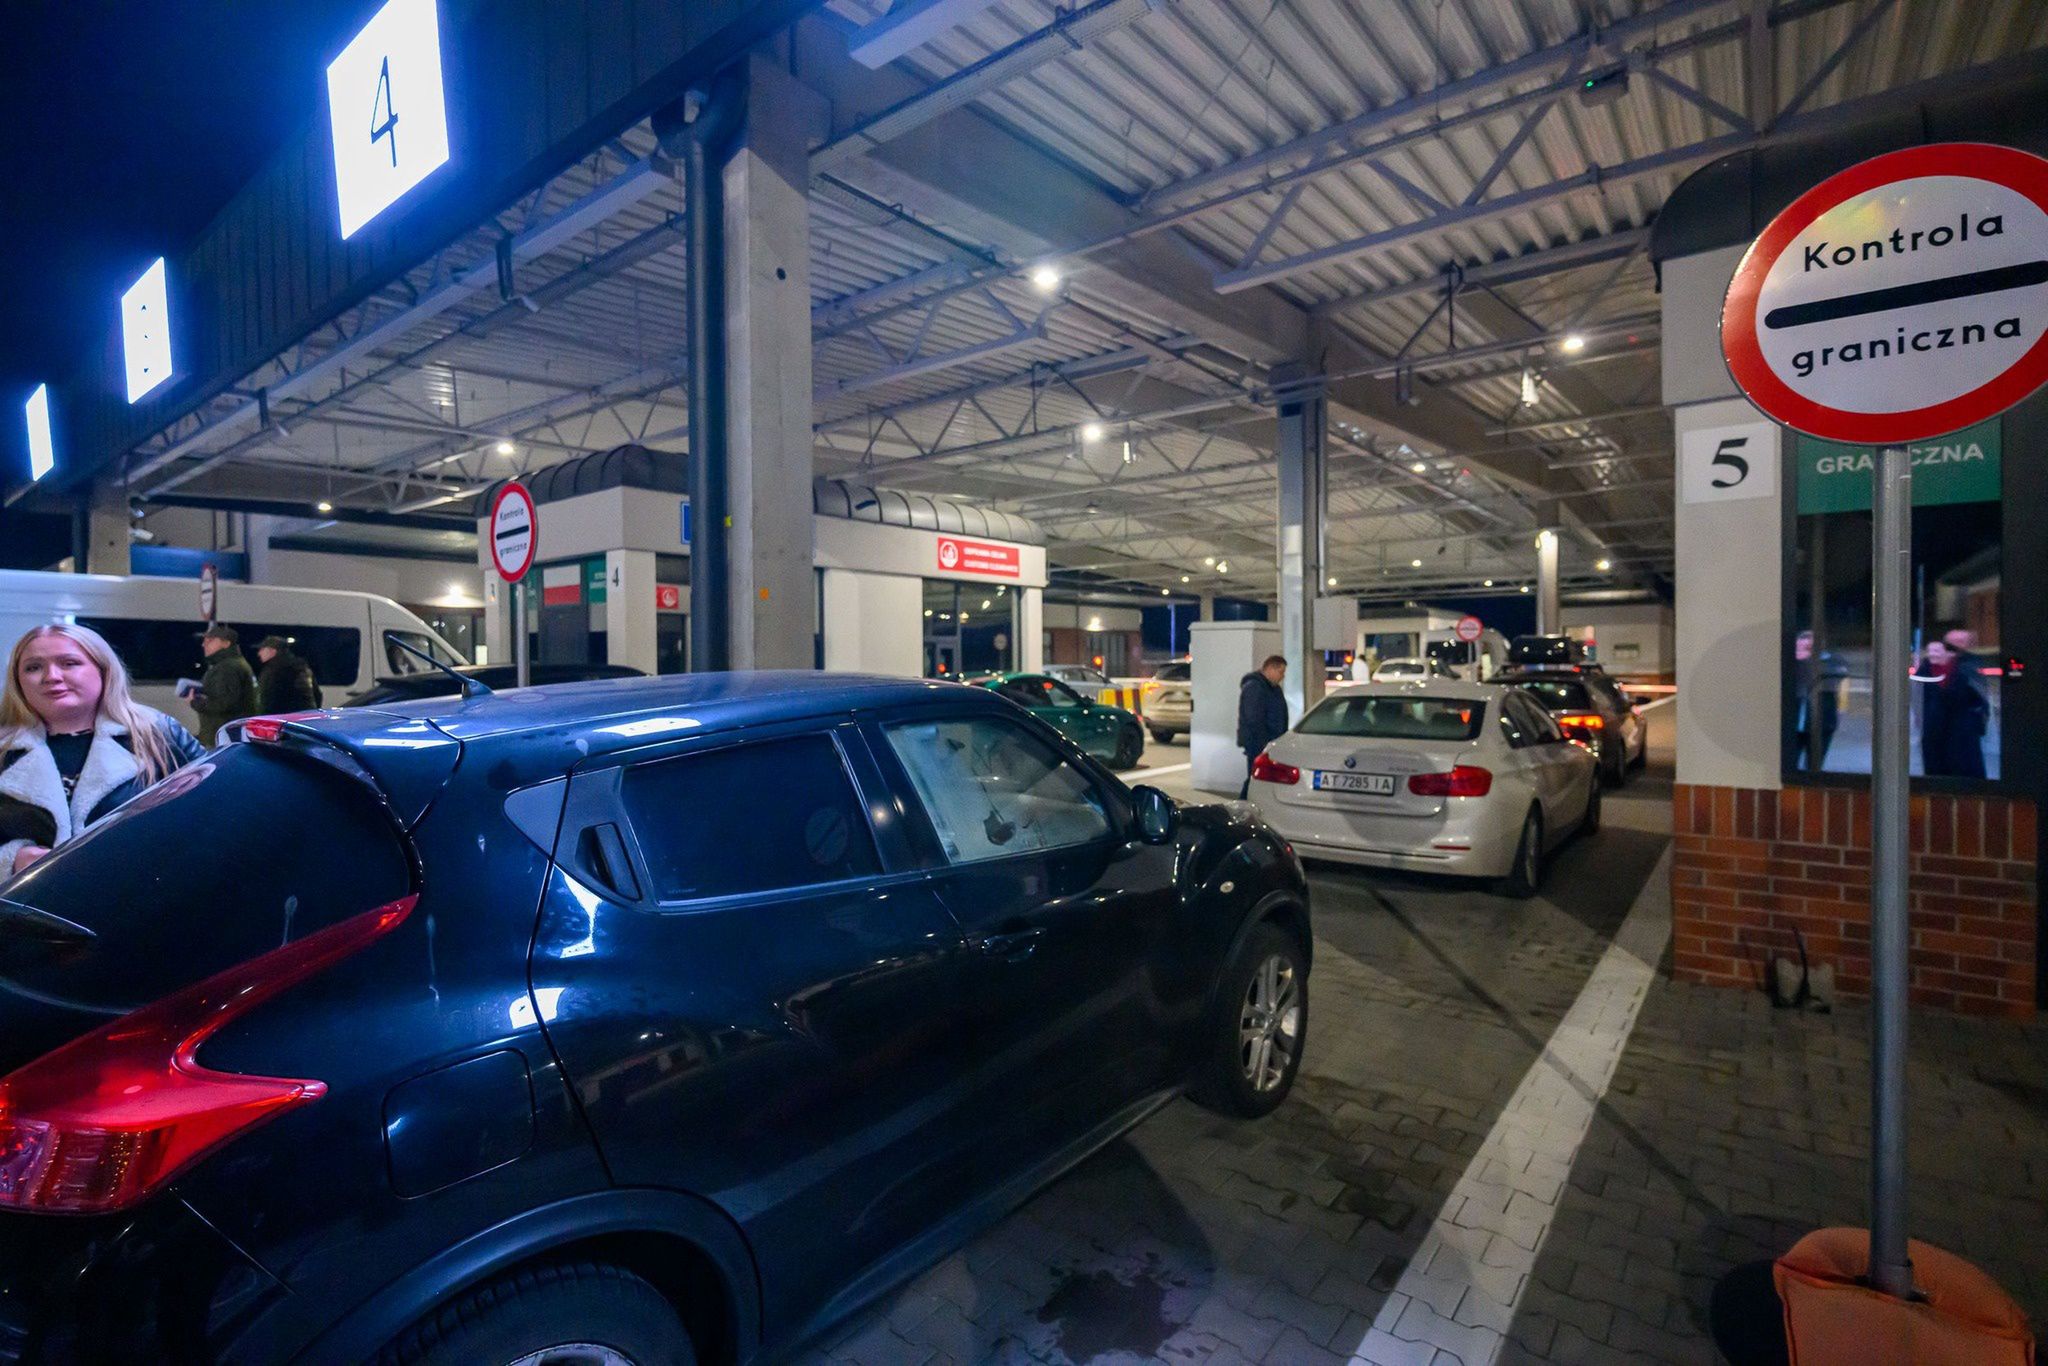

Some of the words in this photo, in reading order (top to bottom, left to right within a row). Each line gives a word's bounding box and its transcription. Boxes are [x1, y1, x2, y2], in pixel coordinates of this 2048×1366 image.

[370, 55, 399, 168] 4
[1804, 213, 2004, 272] Kontrola
[1791, 317, 2022, 377] graniczna
[1711, 436, 1749, 489] 5
[1816, 442, 1984, 474] GRACZNA
[1322, 774, 1339, 786] AT
[1342, 776, 1369, 789] 7285
